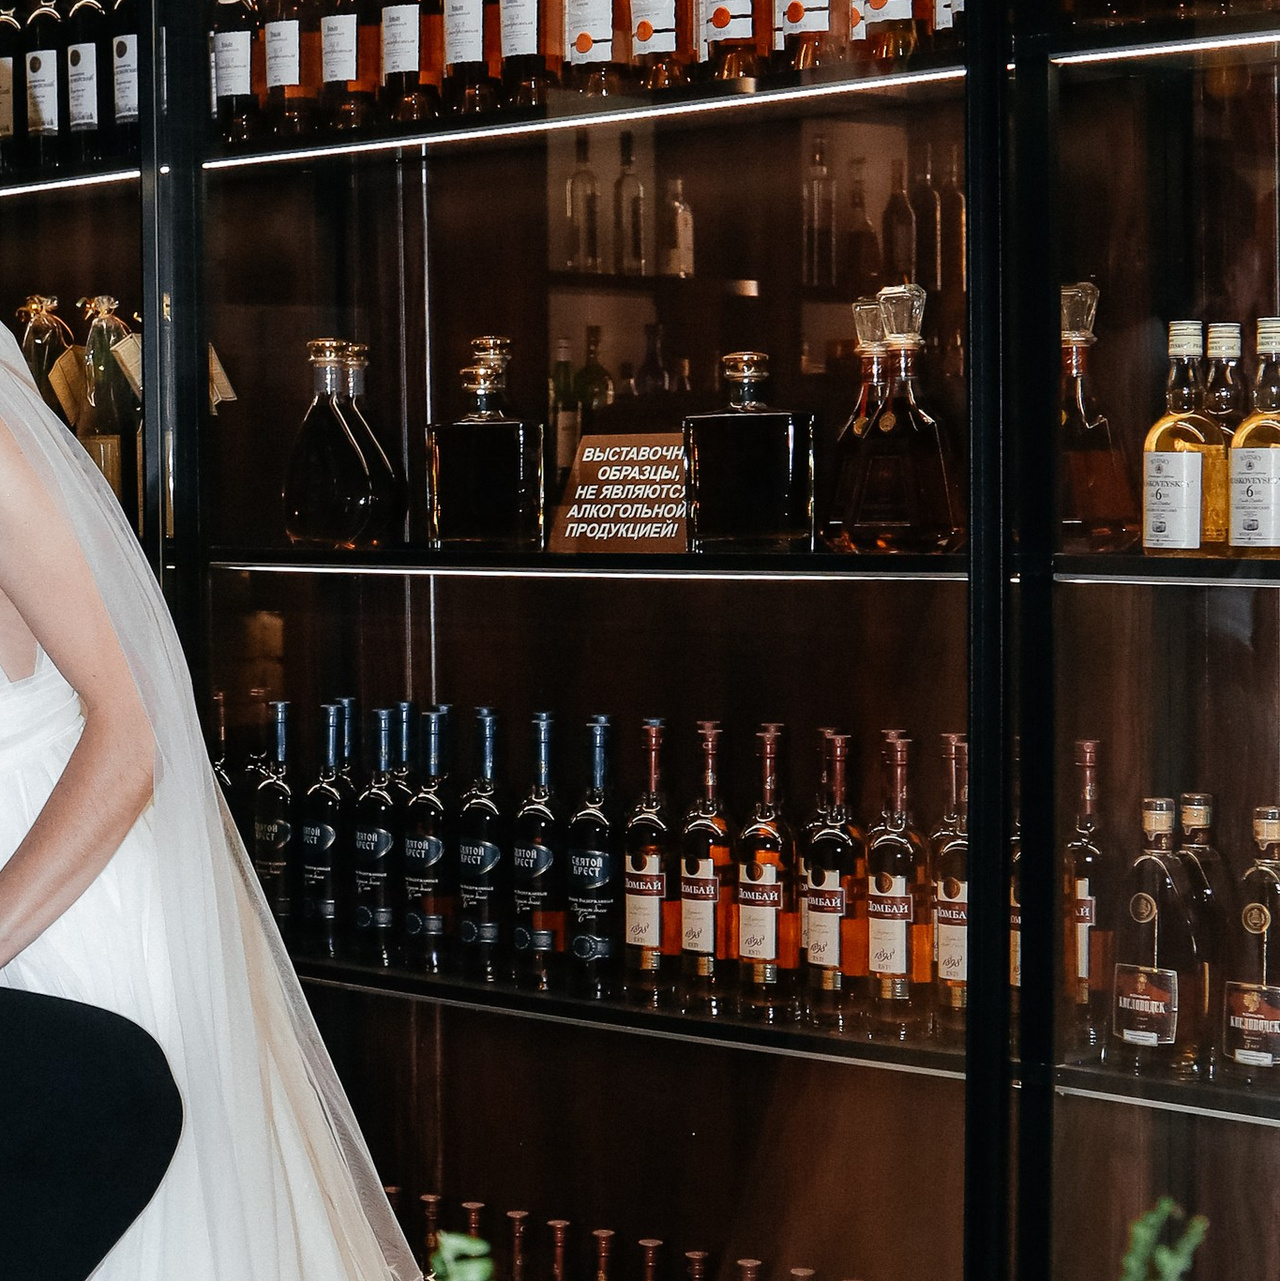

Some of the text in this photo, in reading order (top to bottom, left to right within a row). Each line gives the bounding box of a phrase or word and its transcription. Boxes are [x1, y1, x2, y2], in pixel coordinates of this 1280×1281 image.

[582, 445, 685, 462] ВЫСТАВОЧН
[597, 465, 680, 483] ОБРАЗЦЫ,
[575, 484, 601, 499] НЕ
[1155, 488, 1162, 501] 6
[1246, 485, 1254, 498] 6
[566, 500, 687, 518] АЛКОГОЛЬНОЙ
[565, 519, 678, 540] ПРОДУКЦИЕЙ!
[572, 855, 603, 868] СВЯТОЙ
[573, 866, 600, 877] КРЕСТ
[938, 906, 967, 920] ДОМБА
